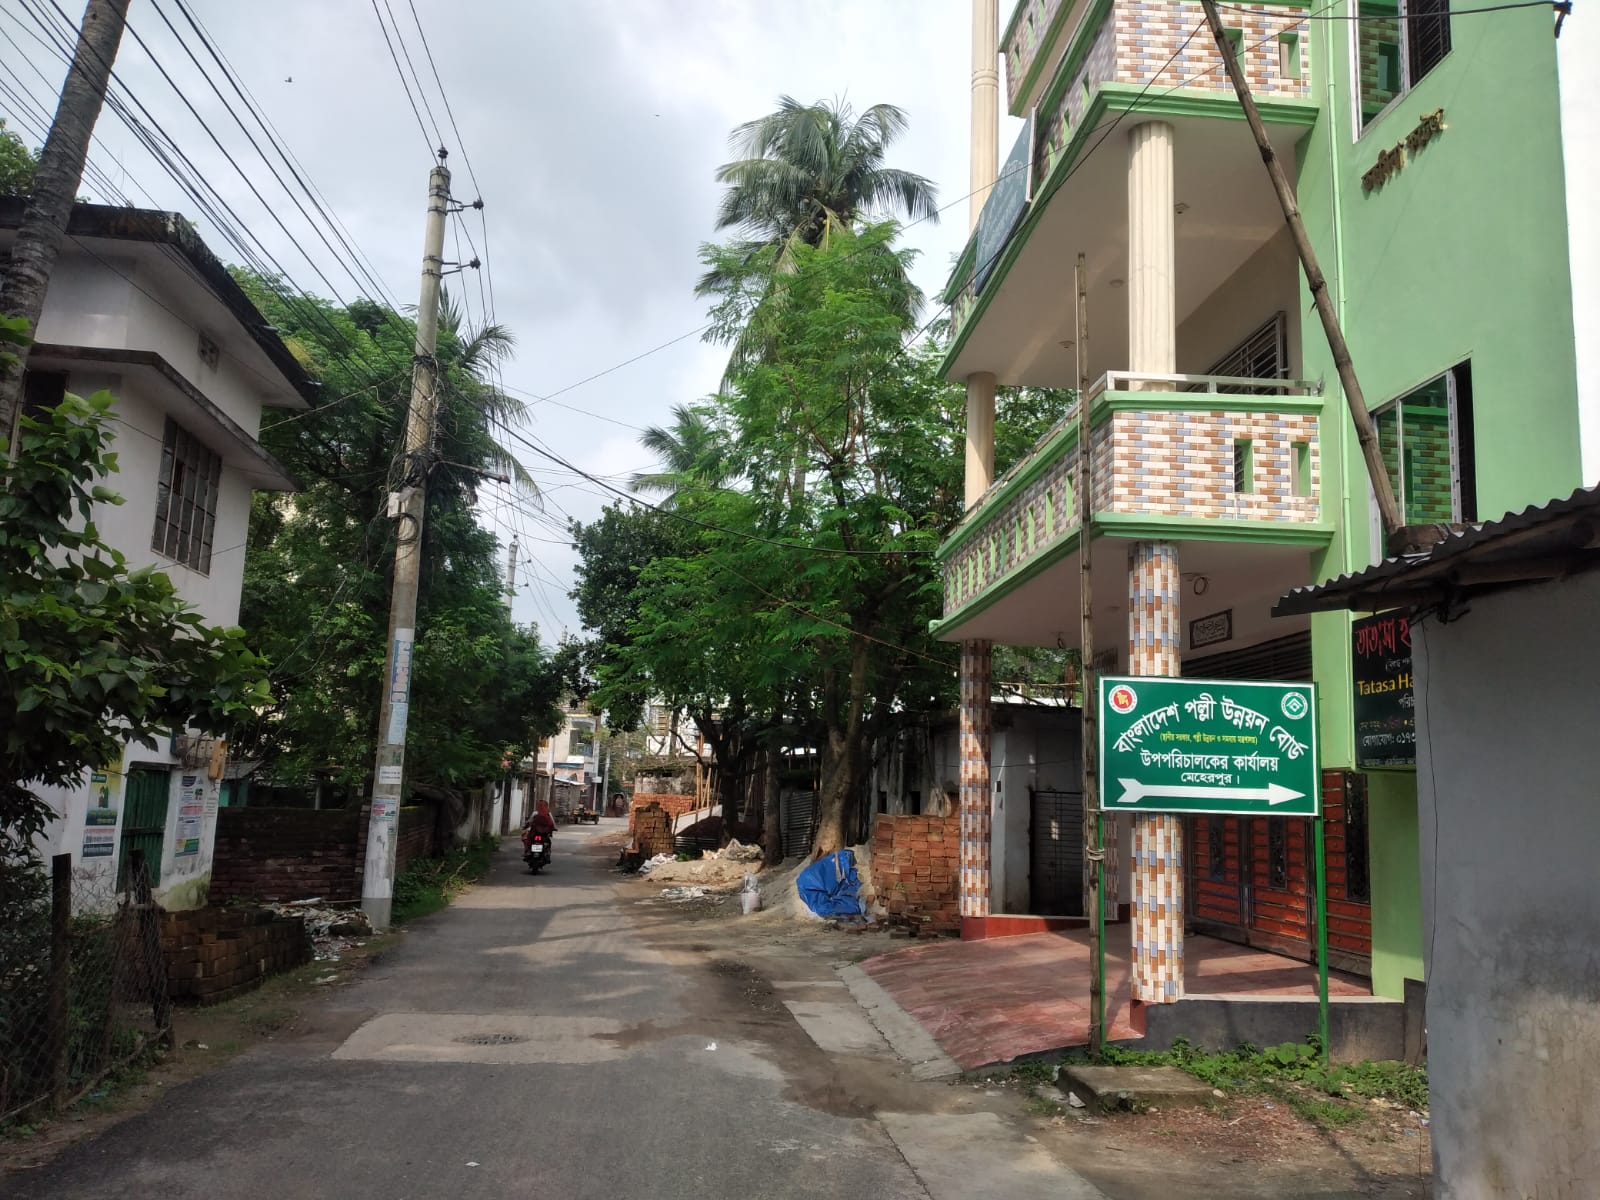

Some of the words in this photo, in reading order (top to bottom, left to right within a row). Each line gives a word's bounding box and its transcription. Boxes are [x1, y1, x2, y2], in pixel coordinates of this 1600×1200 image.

[1357, 679, 1396, 696] Tatasa
[1112, 702, 1181, 753] বাংলাদেশ
[1184, 692, 1218, 722] পল্লী
[1220, 696, 1271, 735] উন্নয়ন
[1269, 725, 1310, 761] বোর্ড
[1140, 748, 1229, 771] উপপরিচালকের
[1233, 751, 1280, 773] কার্যালয়
[1180, 772, 1232, 787] মেহেরপুর
